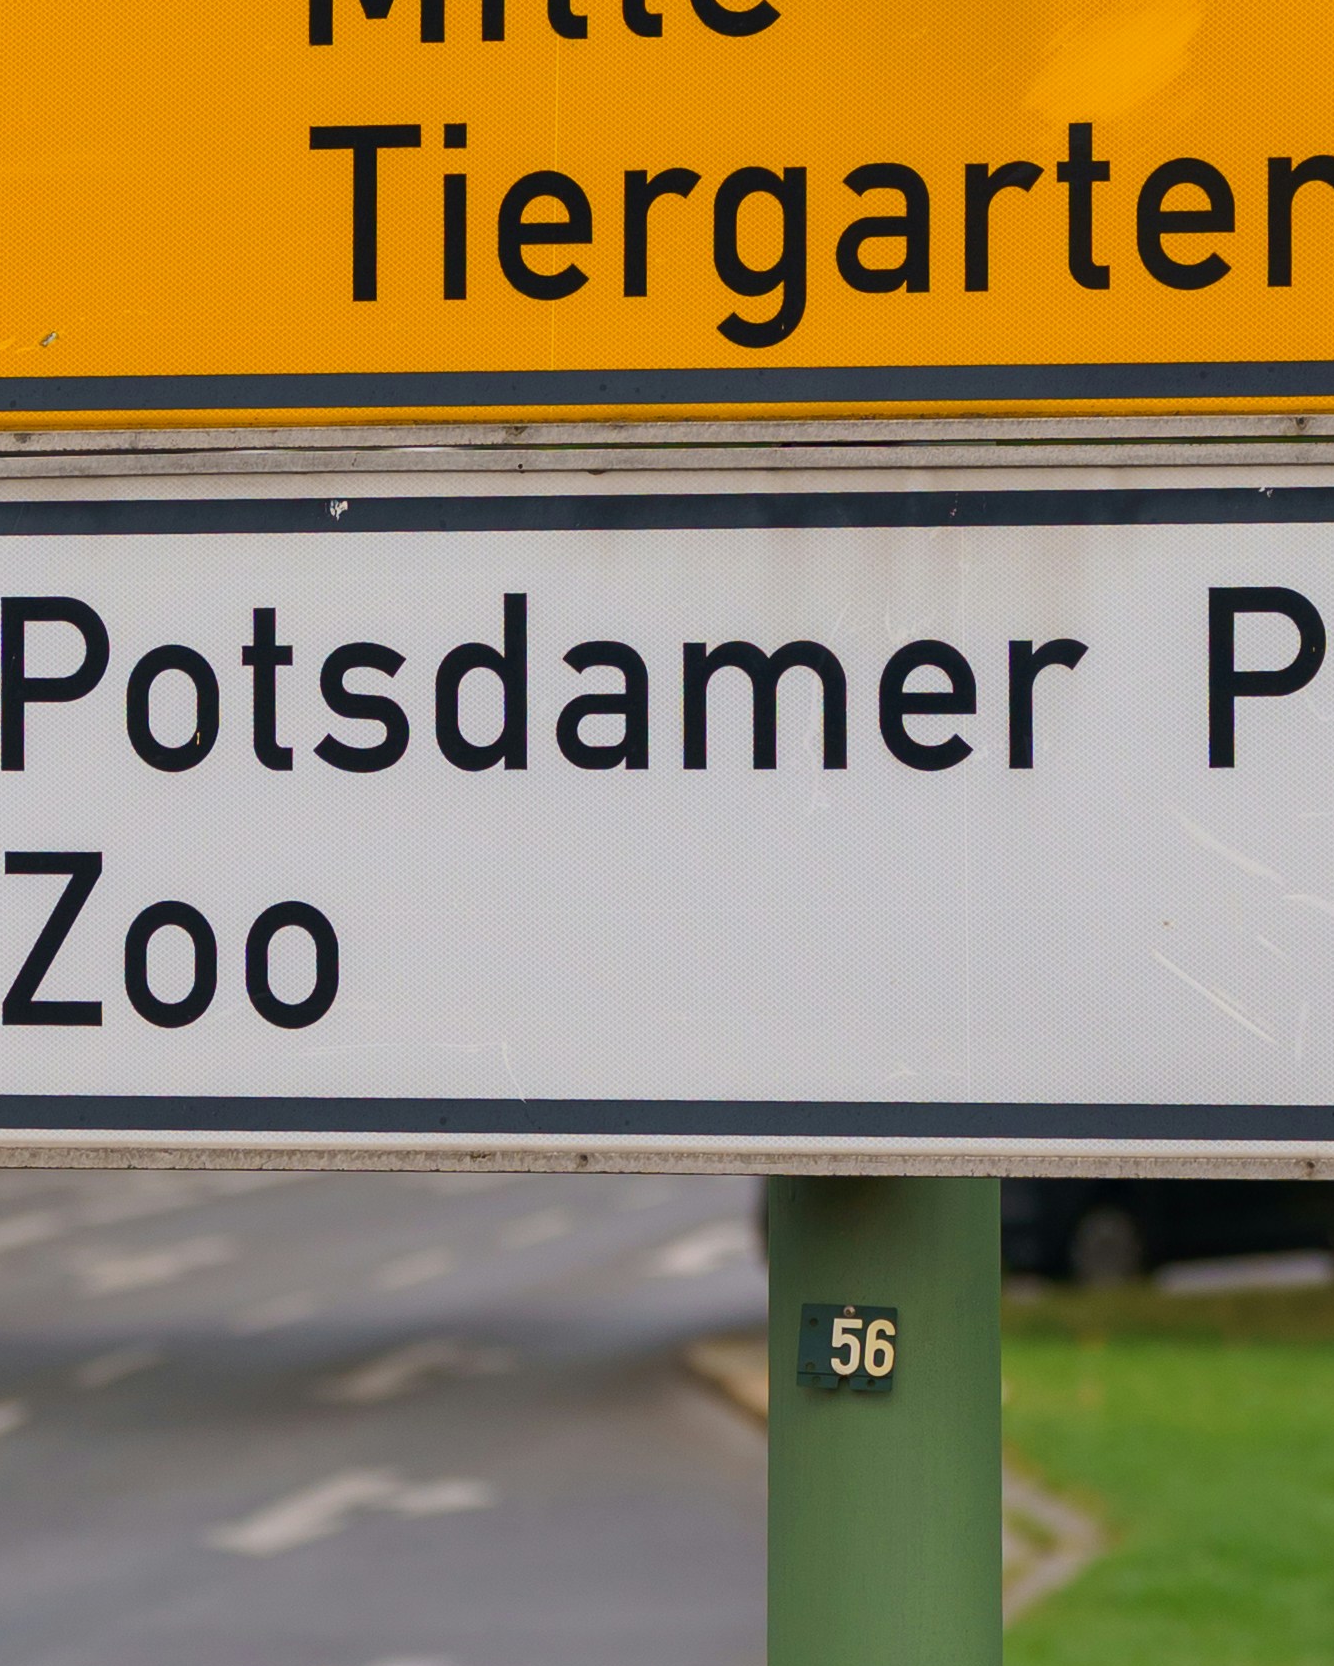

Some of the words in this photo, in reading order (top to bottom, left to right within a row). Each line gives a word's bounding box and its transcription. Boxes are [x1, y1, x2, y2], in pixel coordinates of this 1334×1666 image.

[0, 592, 1089, 774] Potsdamer
[1, 850, 340, 1030] Zoo
[830, 1317, 897, 1378] 56
